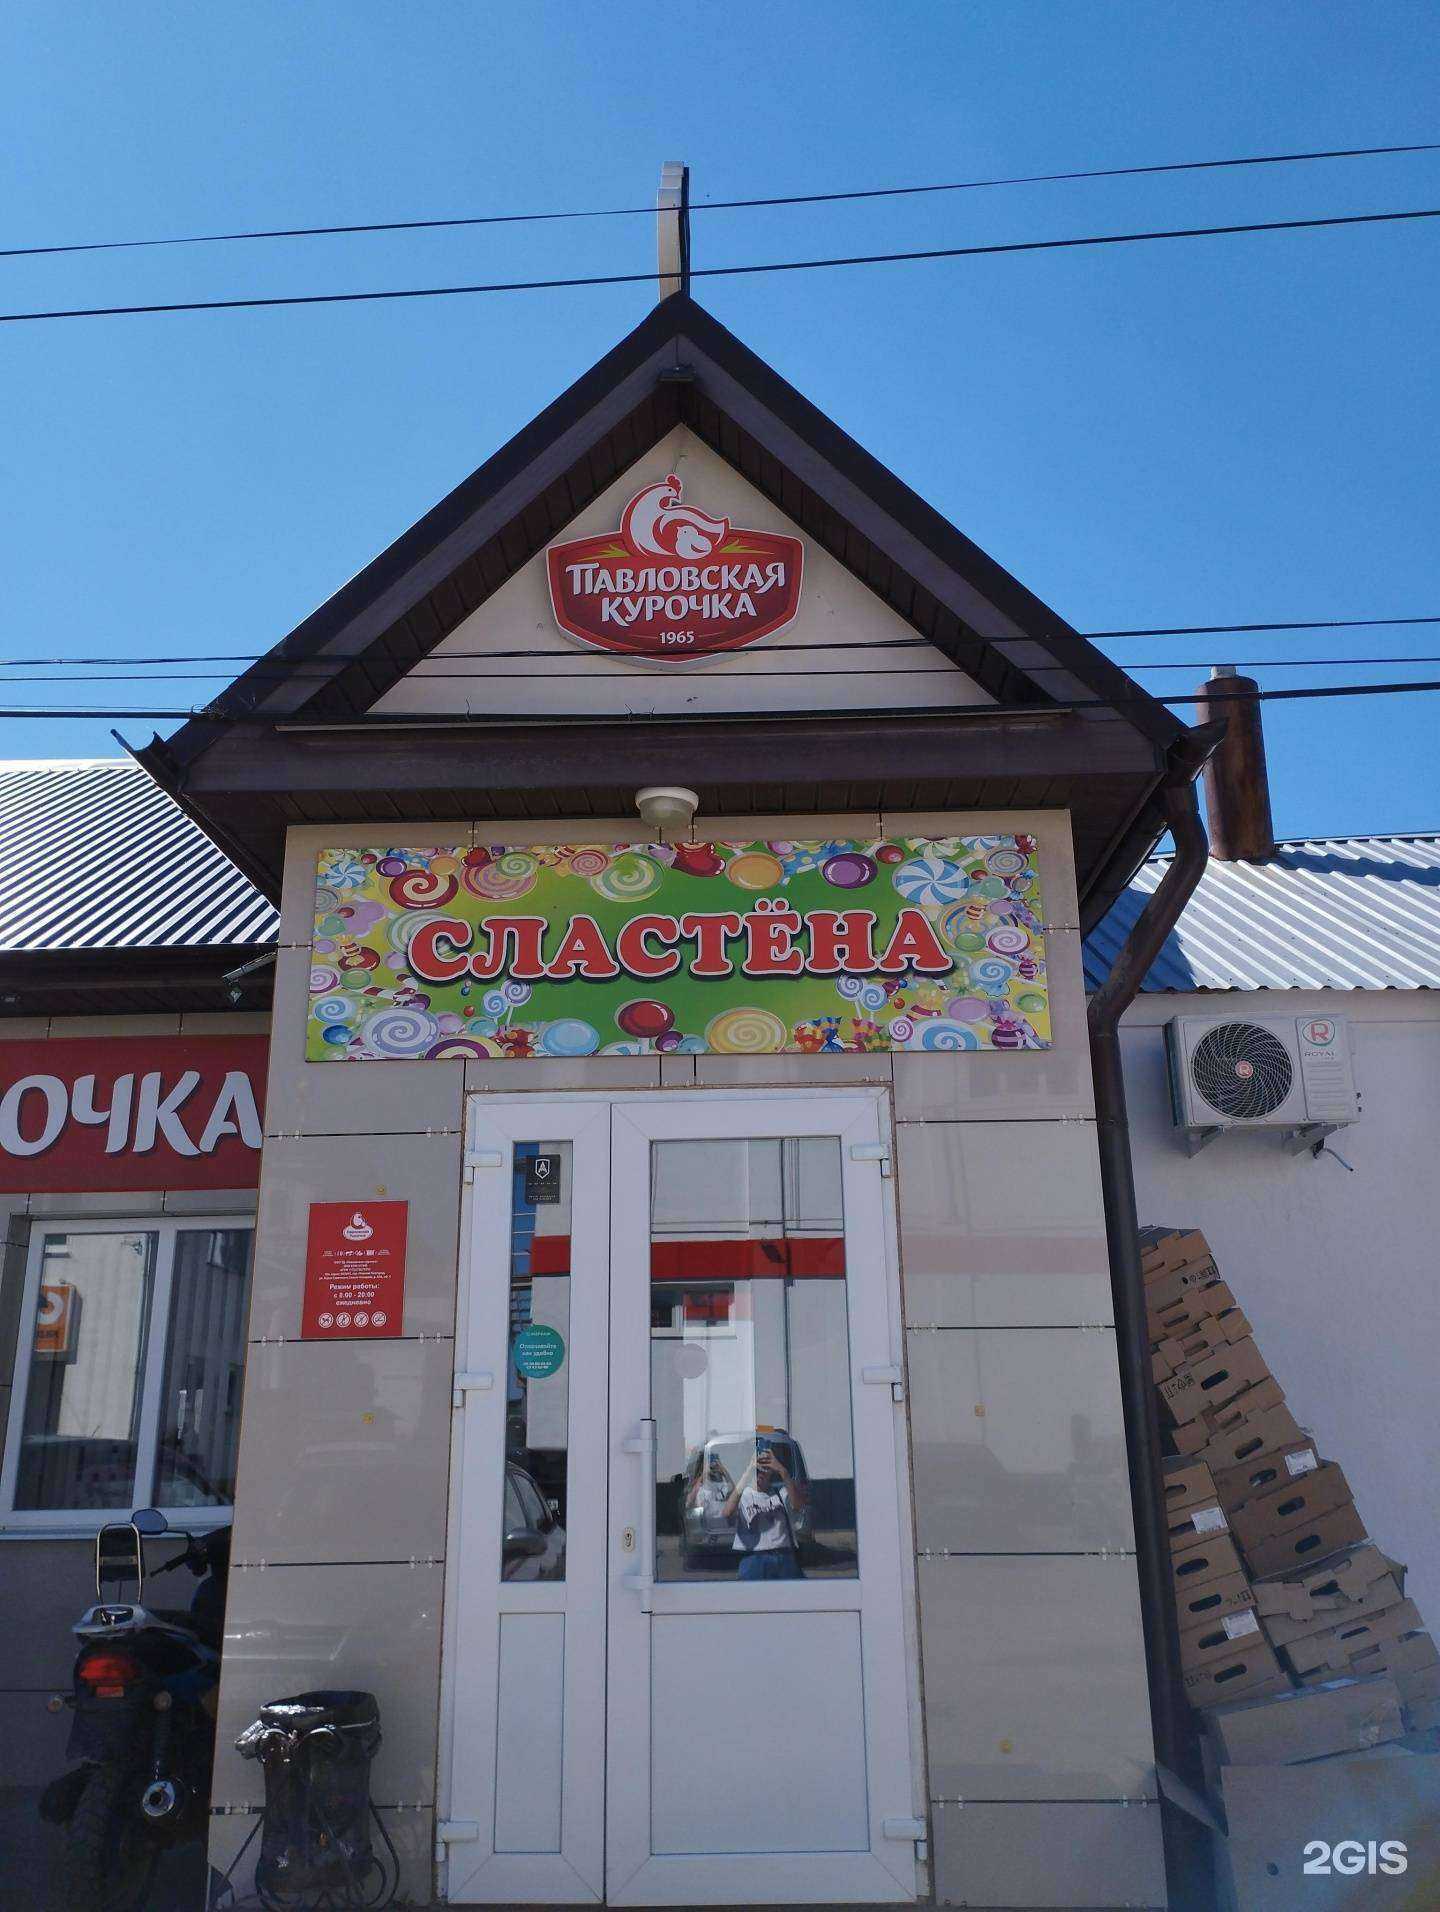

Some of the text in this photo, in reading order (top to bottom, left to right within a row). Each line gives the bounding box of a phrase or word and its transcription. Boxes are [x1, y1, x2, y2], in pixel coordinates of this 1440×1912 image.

[565, 562, 785, 595] ПАВЛОВСКАЯ
[601, 592, 757, 627] КУРОЧКА
[659, 631, 695, 644] 1965
[408, 897, 954, 983] СЛАСТЁНА
[0, 1070, 263, 1156] ОЧКА
